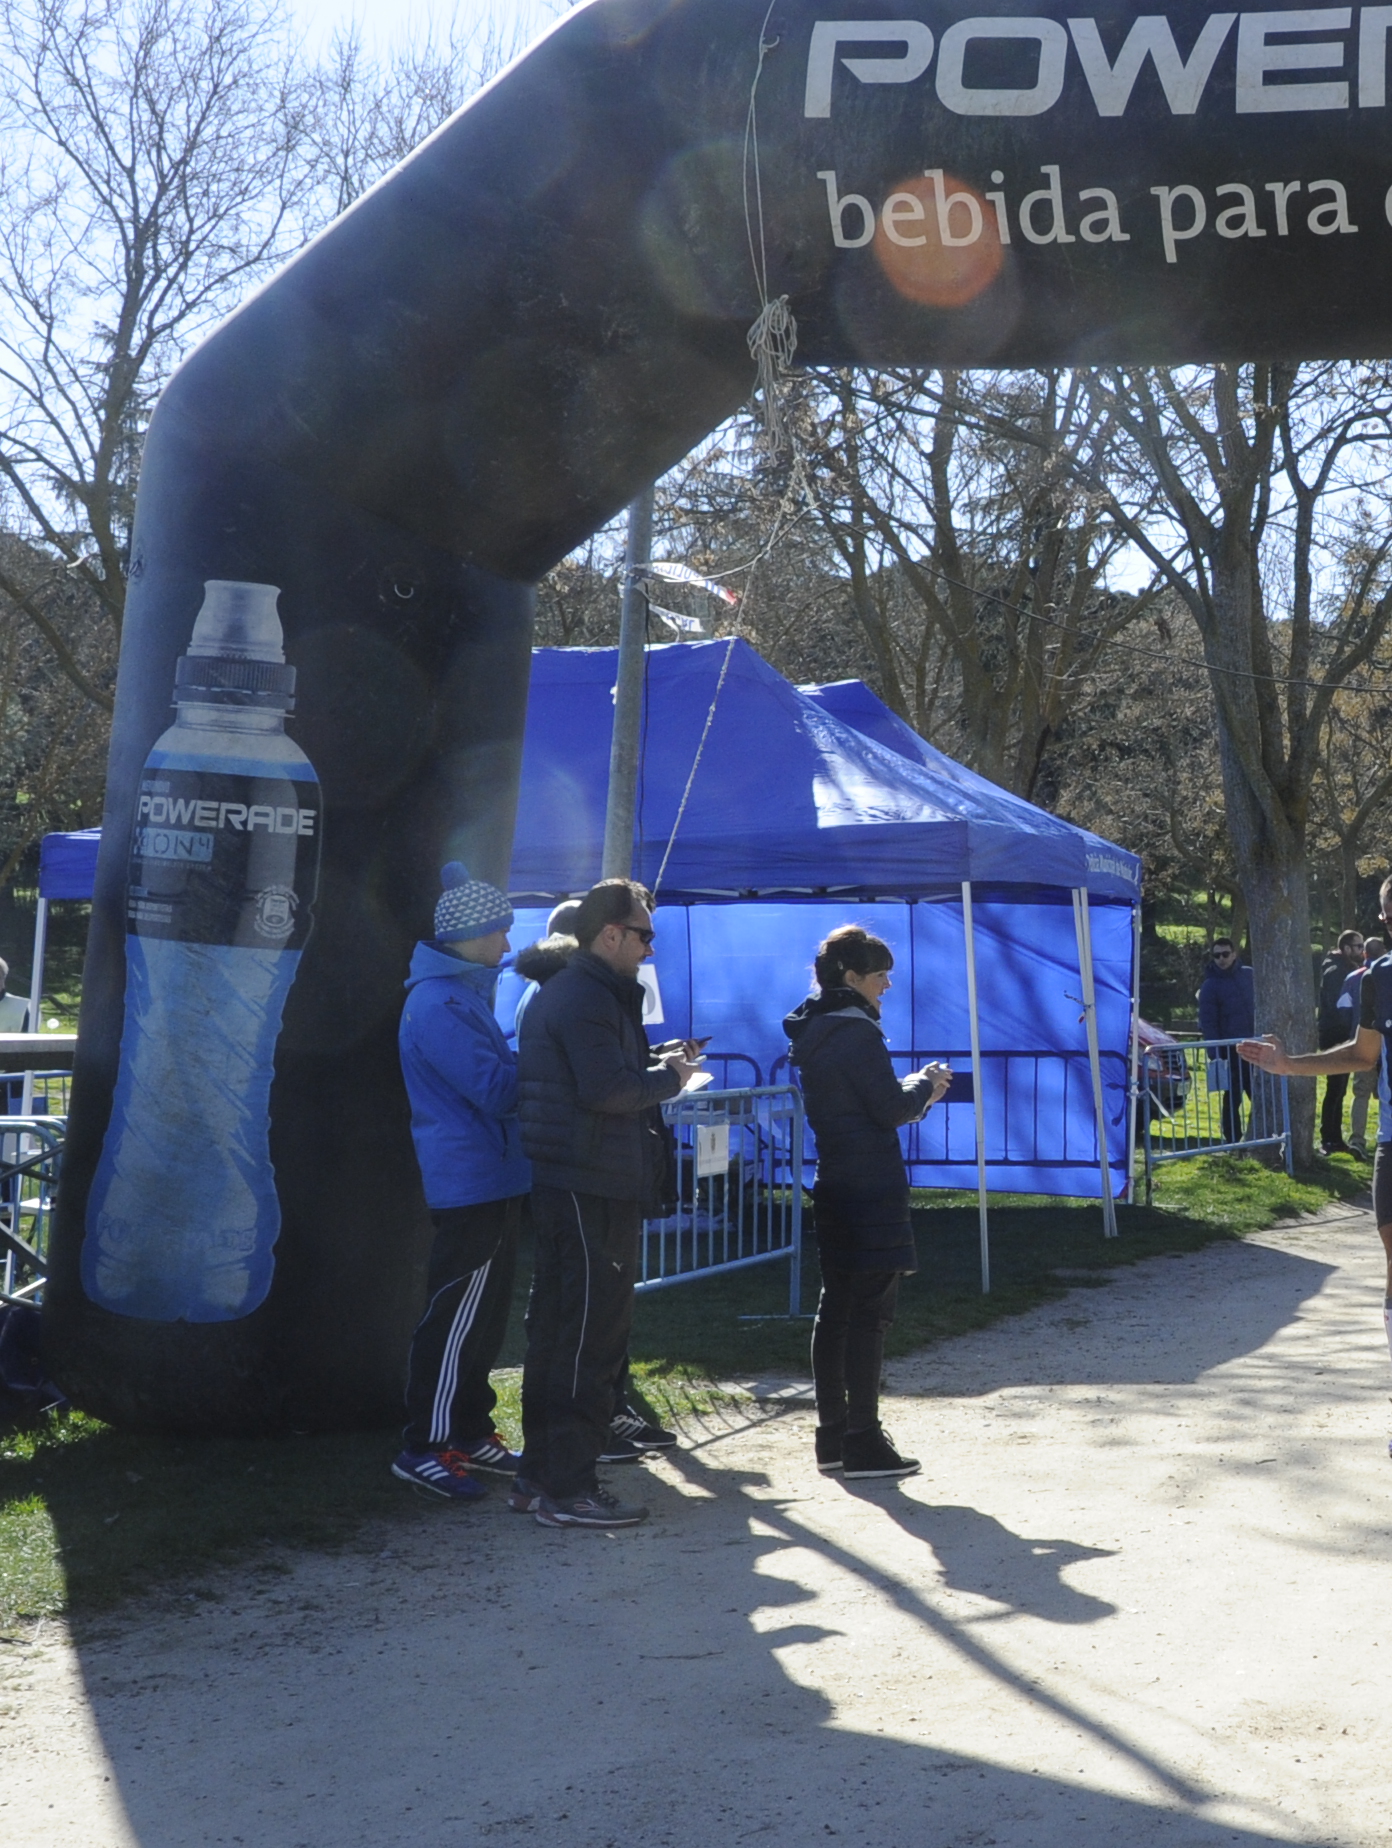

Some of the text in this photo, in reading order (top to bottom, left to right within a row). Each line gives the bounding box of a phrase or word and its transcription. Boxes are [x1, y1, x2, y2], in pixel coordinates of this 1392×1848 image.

[817, 165, 1130, 249] bebida
[1150, 178, 1358, 263] para
[138, 795, 317, 836] POWERADE
